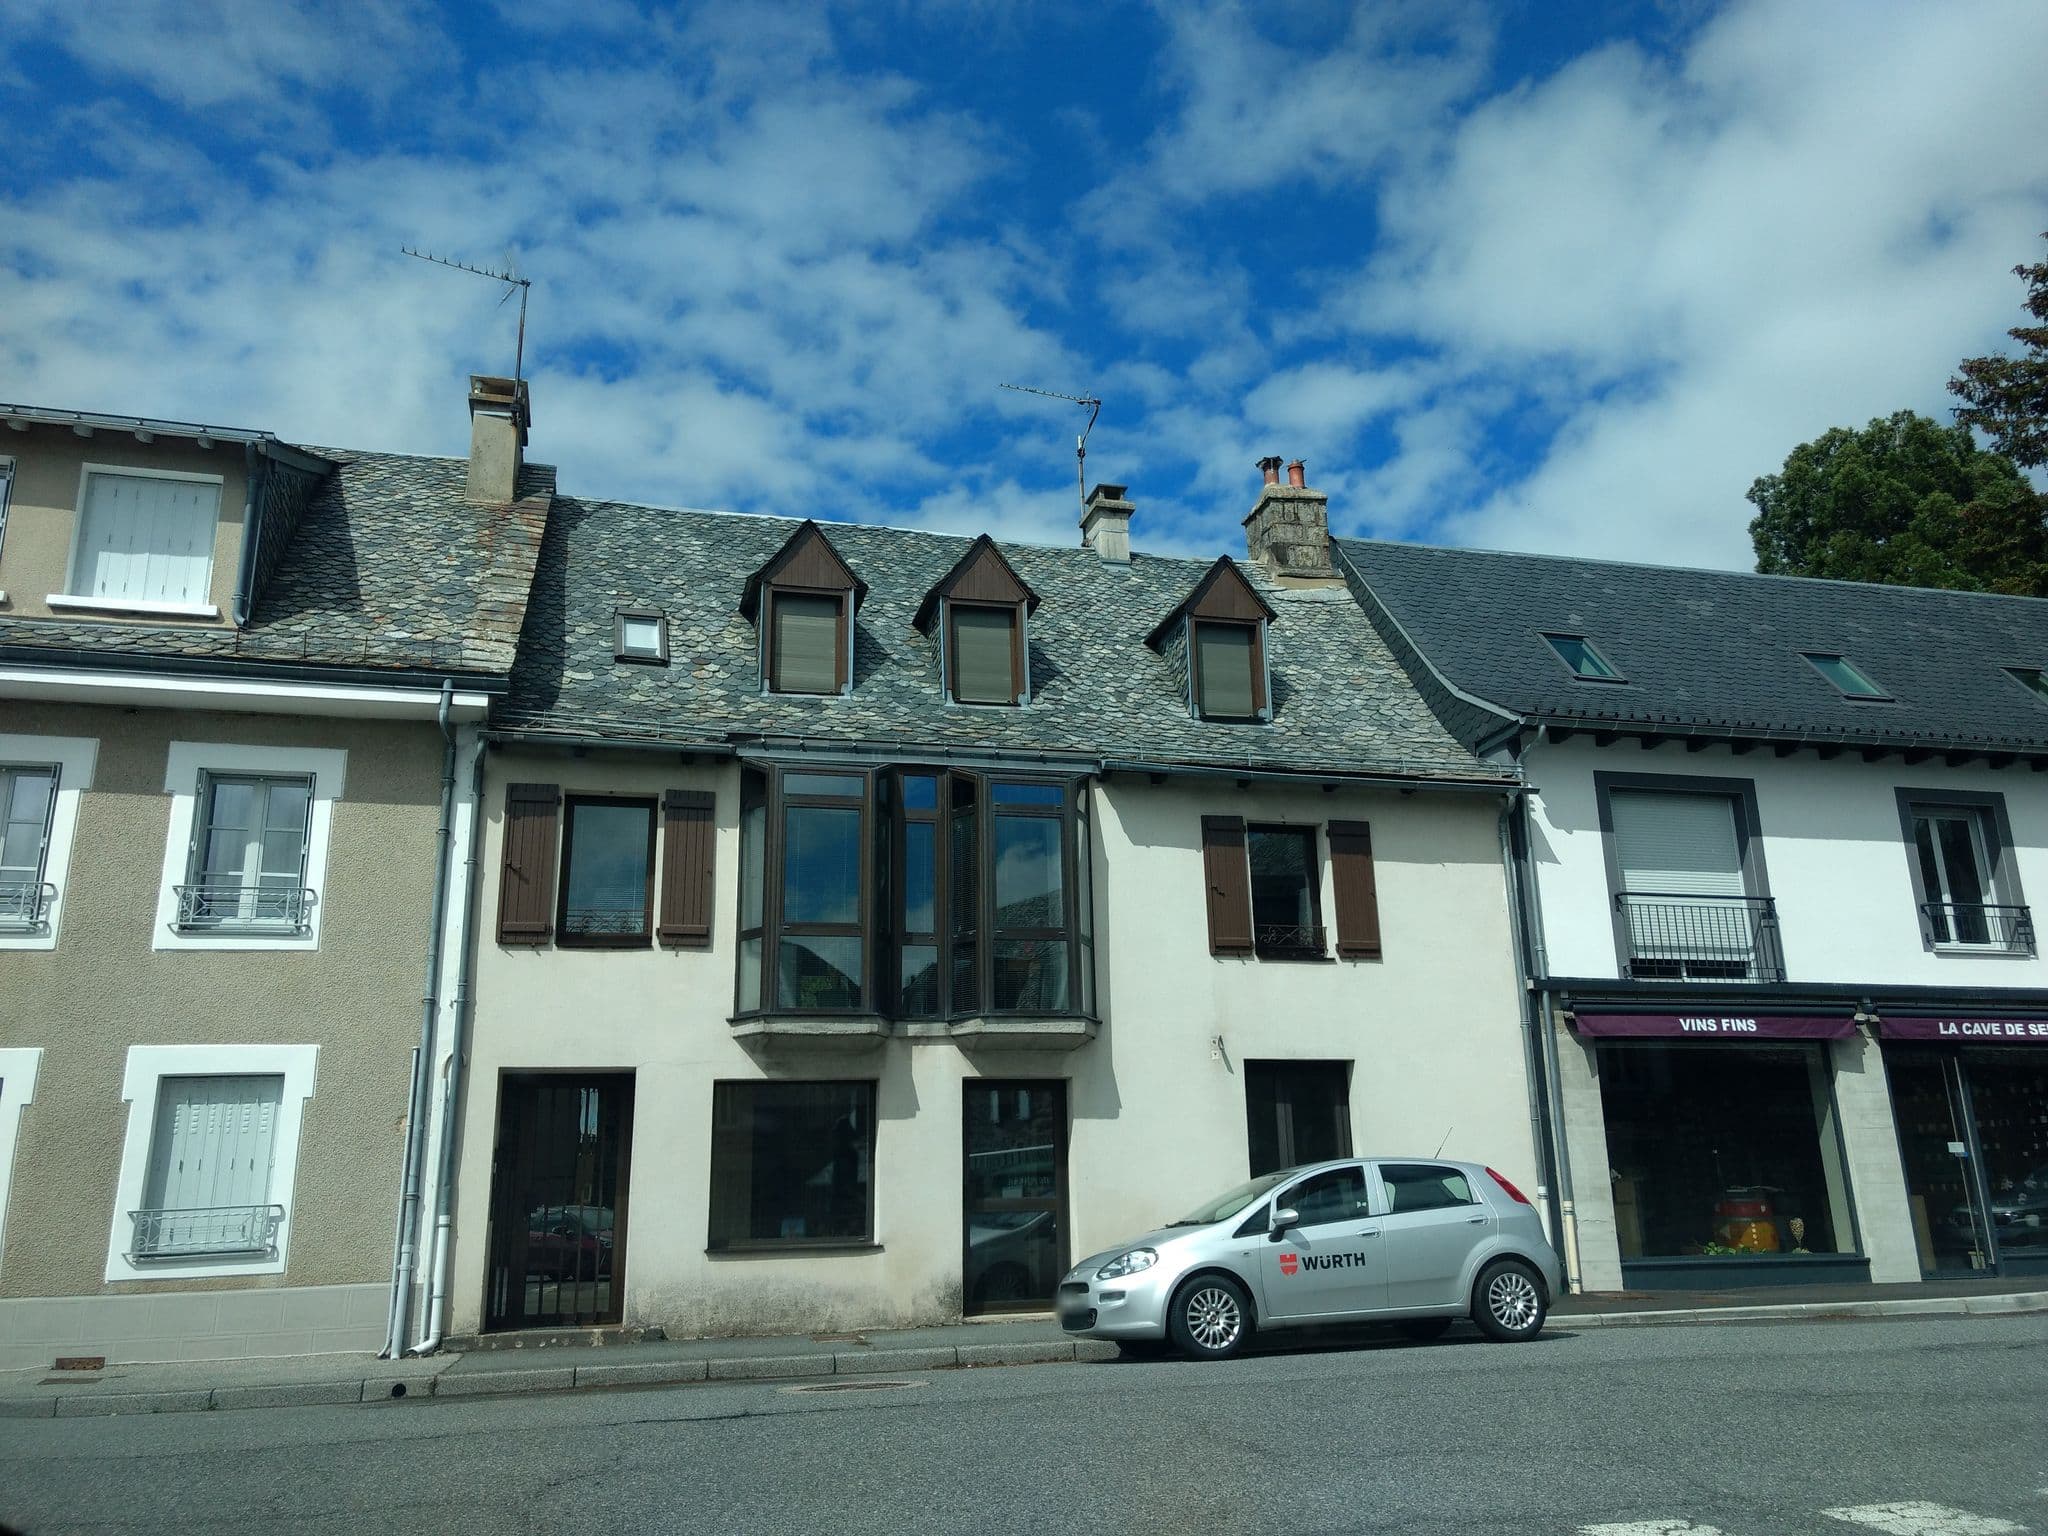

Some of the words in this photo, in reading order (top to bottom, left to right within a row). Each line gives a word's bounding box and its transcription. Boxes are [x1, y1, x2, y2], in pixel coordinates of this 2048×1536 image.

[1679, 1018, 1717, 1031] VINS
[1721, 1018, 1757, 1032] FINS
[1939, 1022, 1959, 1035] LA
[1962, 1022, 2002, 1035] CAVE
[2004, 1023, 2026, 1036] DE
[2028, 1023, 2048, 1036] SE
[1302, 1252, 1366, 1271] WÜRTH
